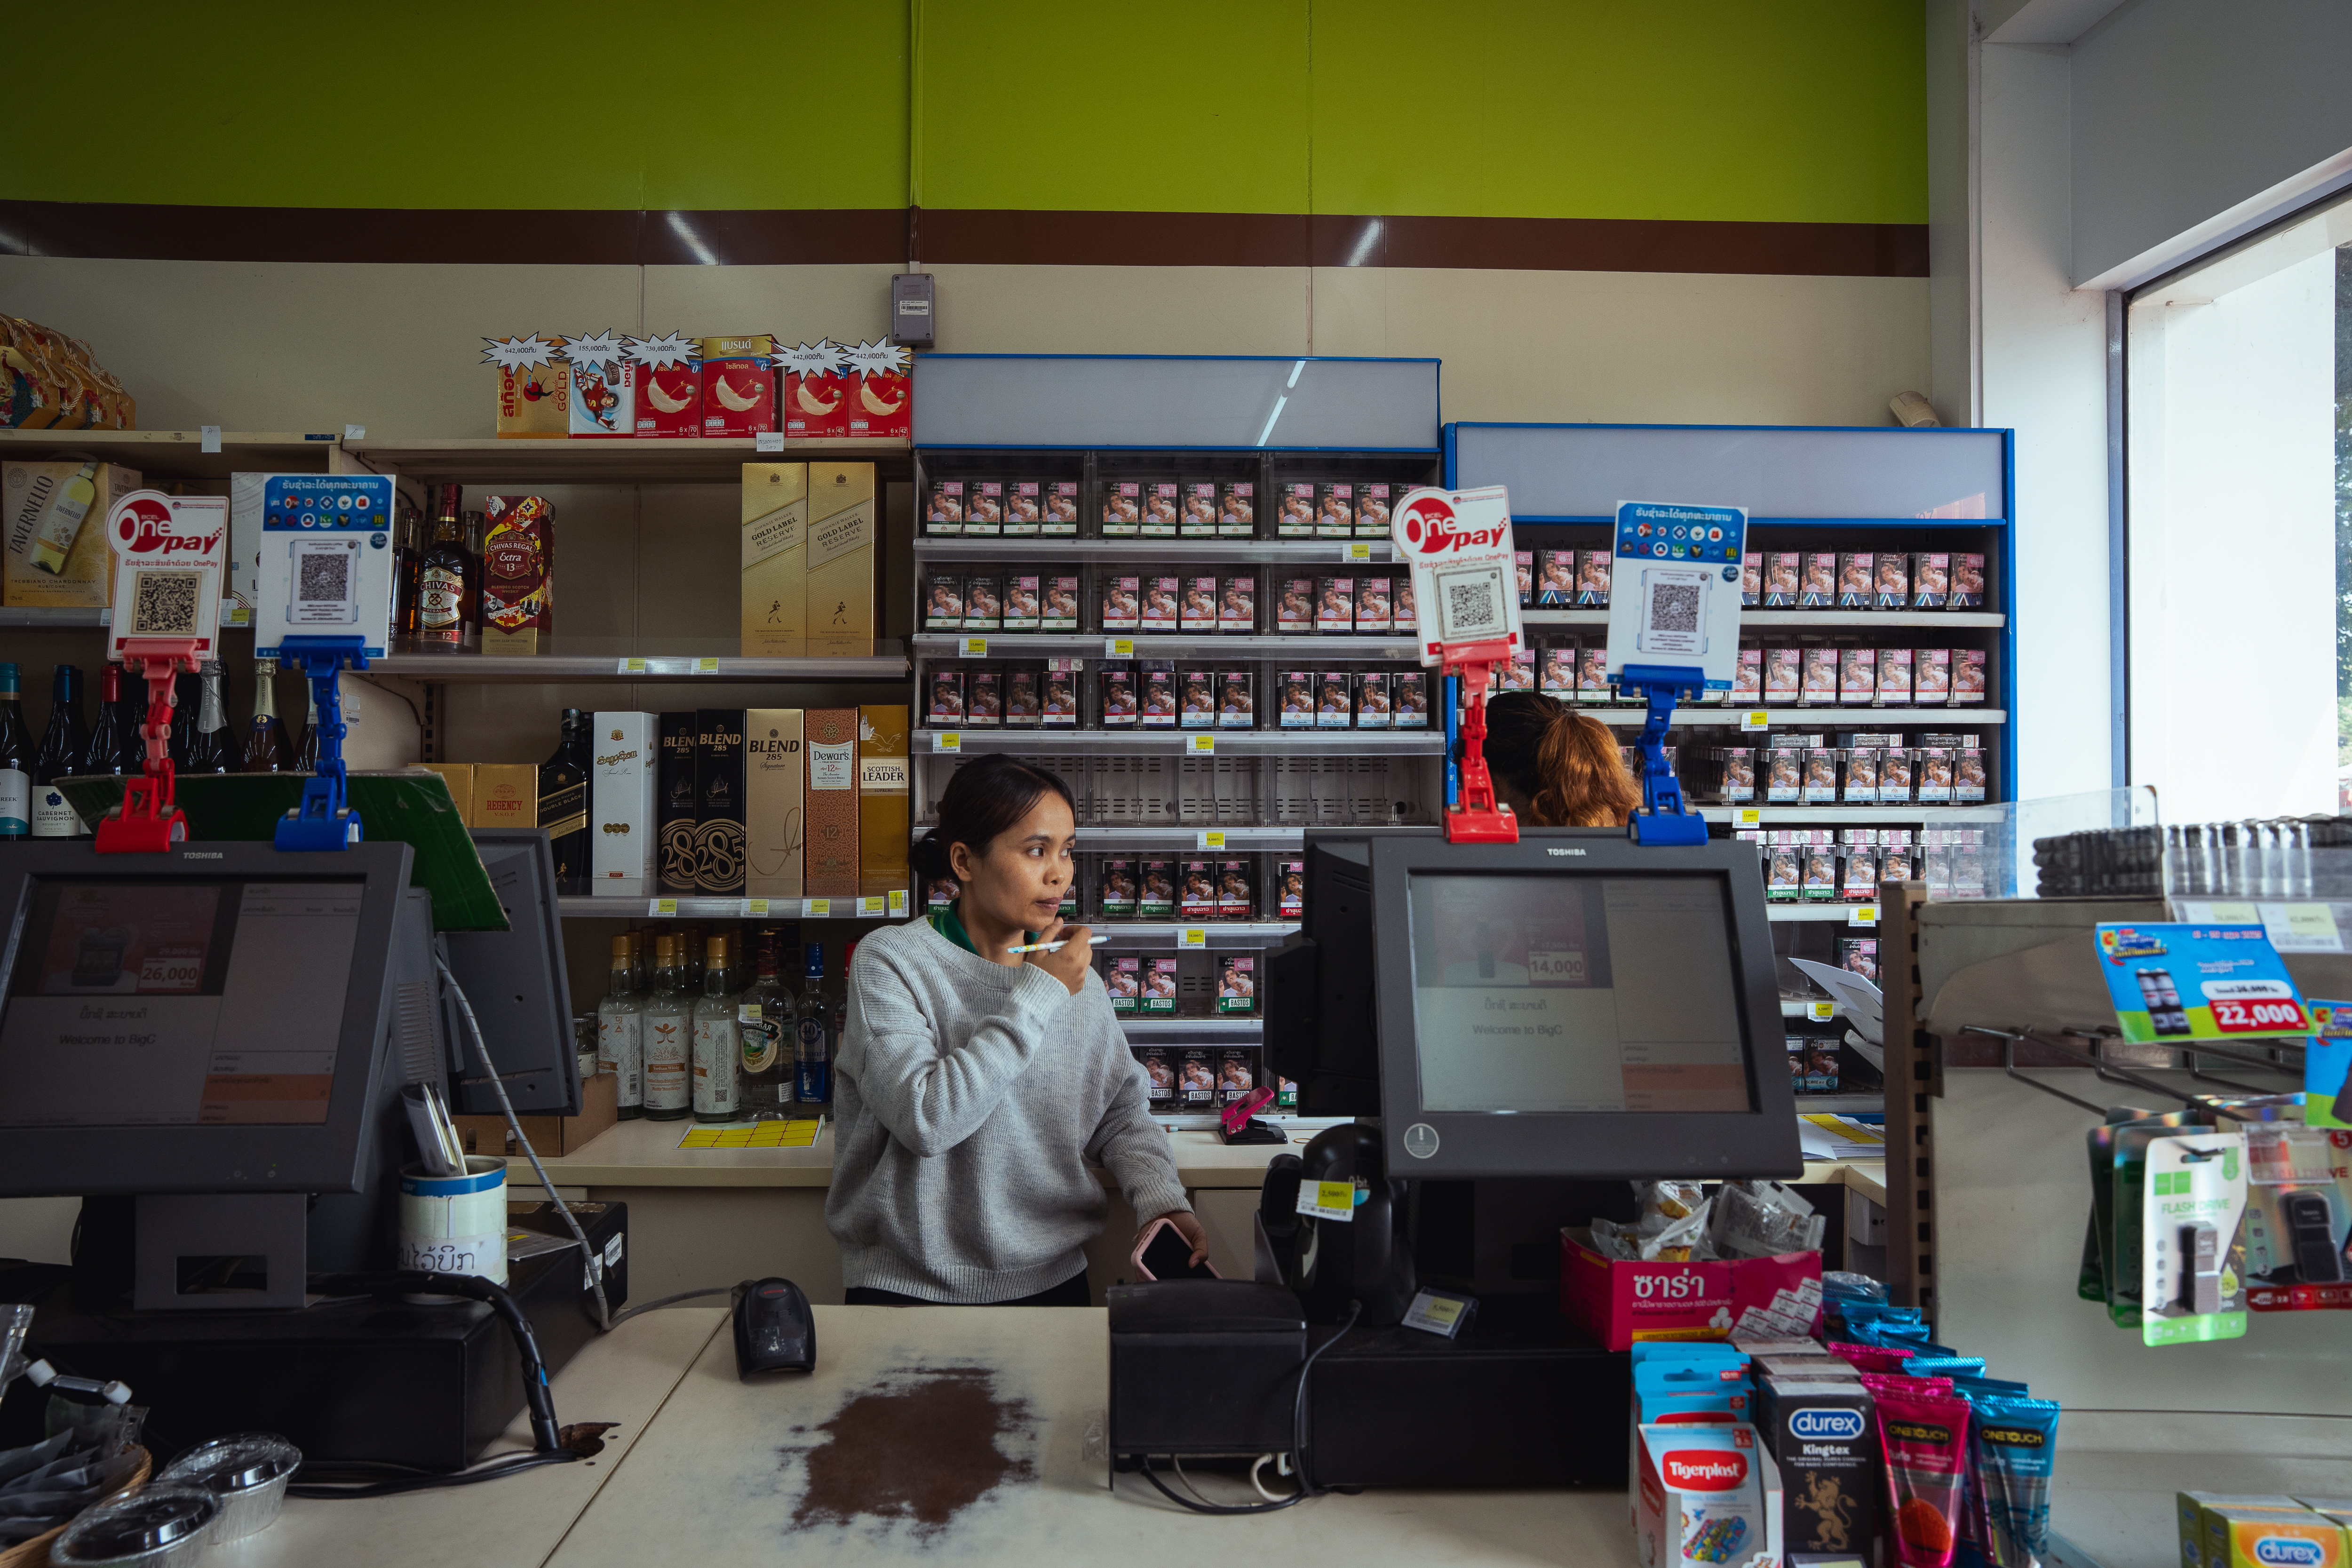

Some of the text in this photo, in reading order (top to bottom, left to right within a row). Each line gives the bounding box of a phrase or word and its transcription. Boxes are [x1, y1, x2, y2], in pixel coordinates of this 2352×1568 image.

[550, 380, 559, 404] Royale
[557, 371, 567, 412] GOLD
[8, 476, 54, 555] TAVERNELLO
[56, 504, 81, 520] TAVERNELLO
[752, 517, 798, 541] GOLD LABEL
[754, 519, 774, 532] JOHNNIE
[818, 518, 864, 541] GOLD LABEL
[820, 520, 840, 533] JOHNNIE
[756, 525, 795, 547] RESERVE
[822, 526, 861, 548] RESERVE
[490, 542, 533, 553] CHIVAS REGAL
[500, 552, 522, 561] Extra
[507, 563, 515, 572] 13
[421, 581, 456, 592] CHIVAS
[442, 632, 452, 640] 12
[663, 736, 696, 747] BLEN
[699, 733, 742, 745] BLEND
[748, 740, 800, 753] BLEND
[596, 750, 638, 766] SangSom
[813, 751, 850, 761] Dewar's
[760, 761, 786, 772] Signature
[863, 772, 905, 781] LEADER
[486, 801, 523, 811] REGENCY
[540, 794, 582, 813] DOUBLE BLACK
[826, 827, 837, 839] 12
[696, 831, 744, 879] 285
[1530, 958, 1583, 975] 14,000
[143, 967, 198, 983] 26,000
[2216, 1004, 2299, 1027] 22,000
[802, 1025, 816, 1036] 40
[1472, 1025, 1563, 1037] Welcome to BigC
[60, 1034, 156, 1047] Welcome to BigC
[2161, 1199, 2230, 1214] FLASH DRIVE
[1633, 1268, 1705, 1298] ซาร่า
[1796, 1413, 1859, 1435] durex
[1888, 1425, 1949, 1442] ONETOUCH
[1981, 1429, 2043, 1445] ONETOUCH
[1803, 1444, 1850, 1457] Kingtex
[1669, 1460, 1740, 1480] Tigerplast
[2258, 1541, 2316, 1560] durex
